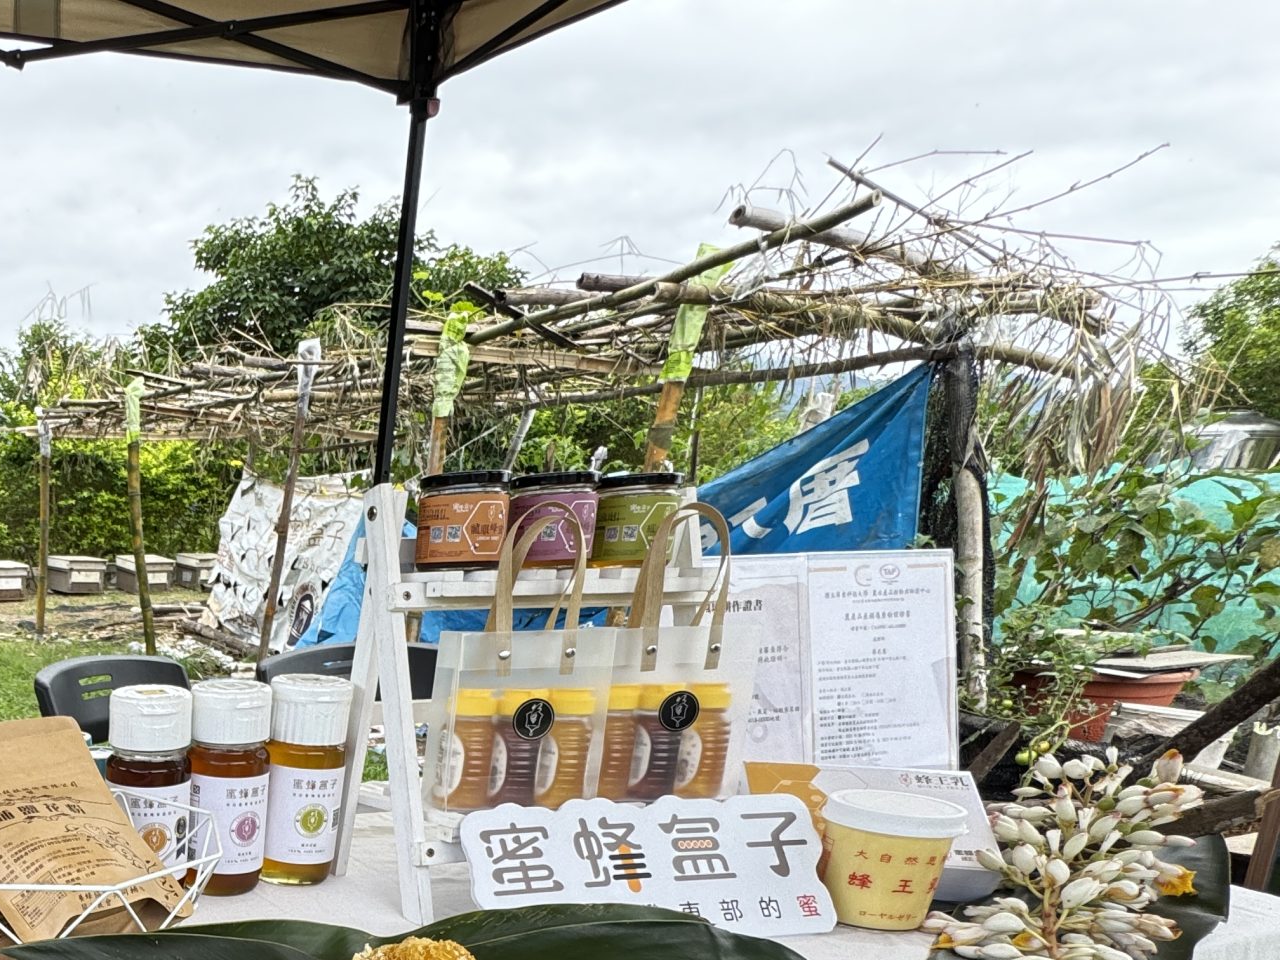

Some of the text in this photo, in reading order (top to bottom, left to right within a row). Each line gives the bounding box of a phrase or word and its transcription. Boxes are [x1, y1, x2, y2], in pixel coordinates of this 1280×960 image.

[479, 811, 808, 897] 蜜蜂盒子
[854, 849, 949, 866] 大自然恩
[646, 894, 822, 922] 東部的蜜
